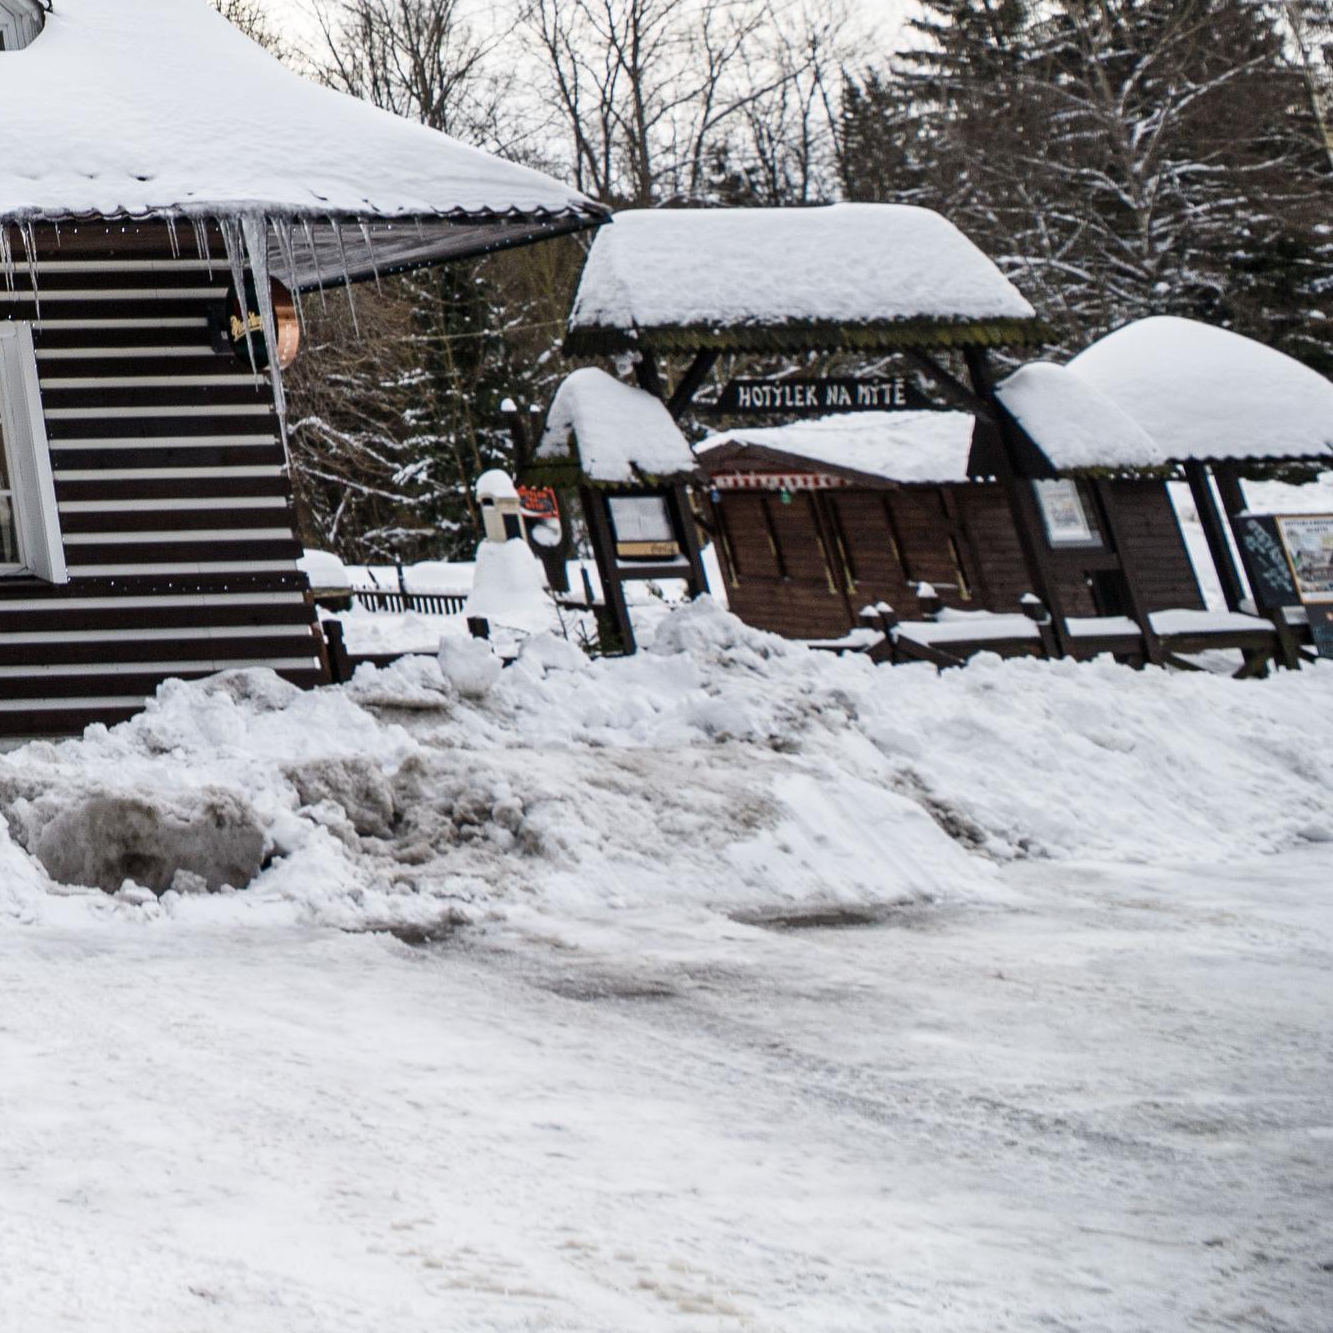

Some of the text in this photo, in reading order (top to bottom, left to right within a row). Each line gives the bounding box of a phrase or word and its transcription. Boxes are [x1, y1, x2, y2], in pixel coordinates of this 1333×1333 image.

[738, 378, 906, 407] HOTÝLEK NA MÝTĚ
